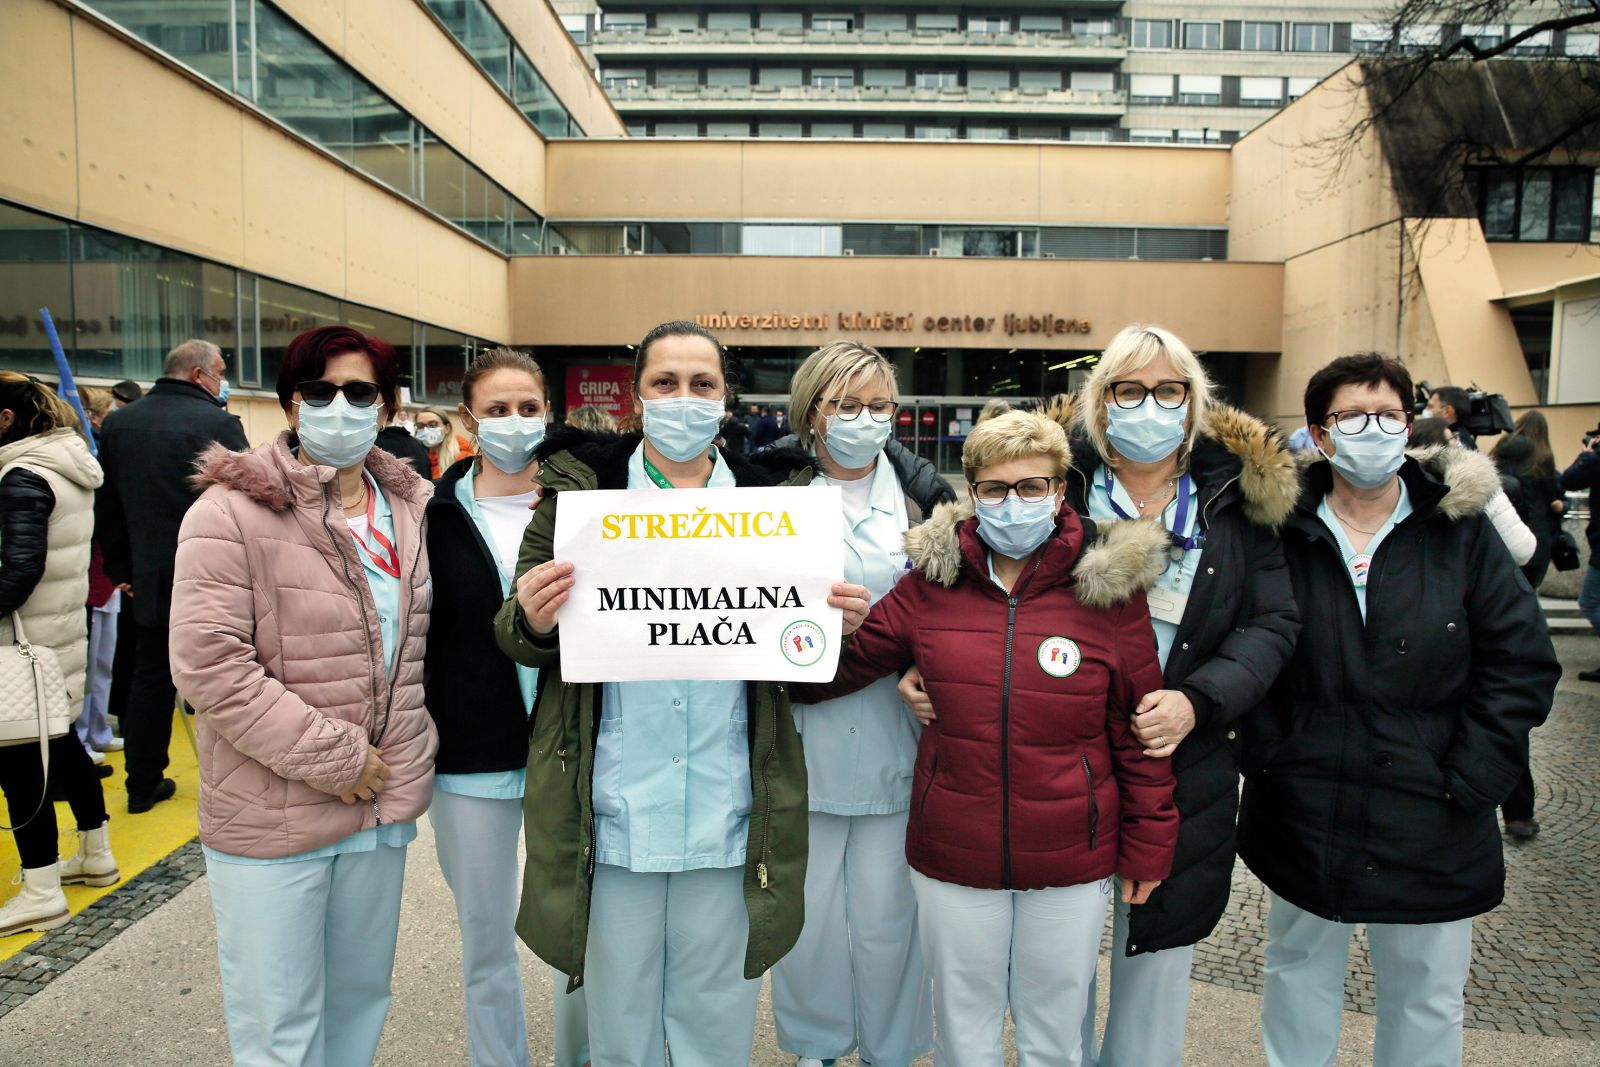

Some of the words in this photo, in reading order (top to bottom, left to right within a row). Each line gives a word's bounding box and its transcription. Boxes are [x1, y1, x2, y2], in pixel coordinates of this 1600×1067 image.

[695, 311, 830, 331] univerzitetni
[838, 311, 914, 332] klinični
[923, 314, 995, 333] center
[1003, 313, 1091, 338] ljubljana
[579, 381, 620, 395] GRIPA
[602, 505, 798, 540] STREŽNICA
[596, 585, 805, 612] MINIMALNA
[647, 615, 757, 647] PLAČA
